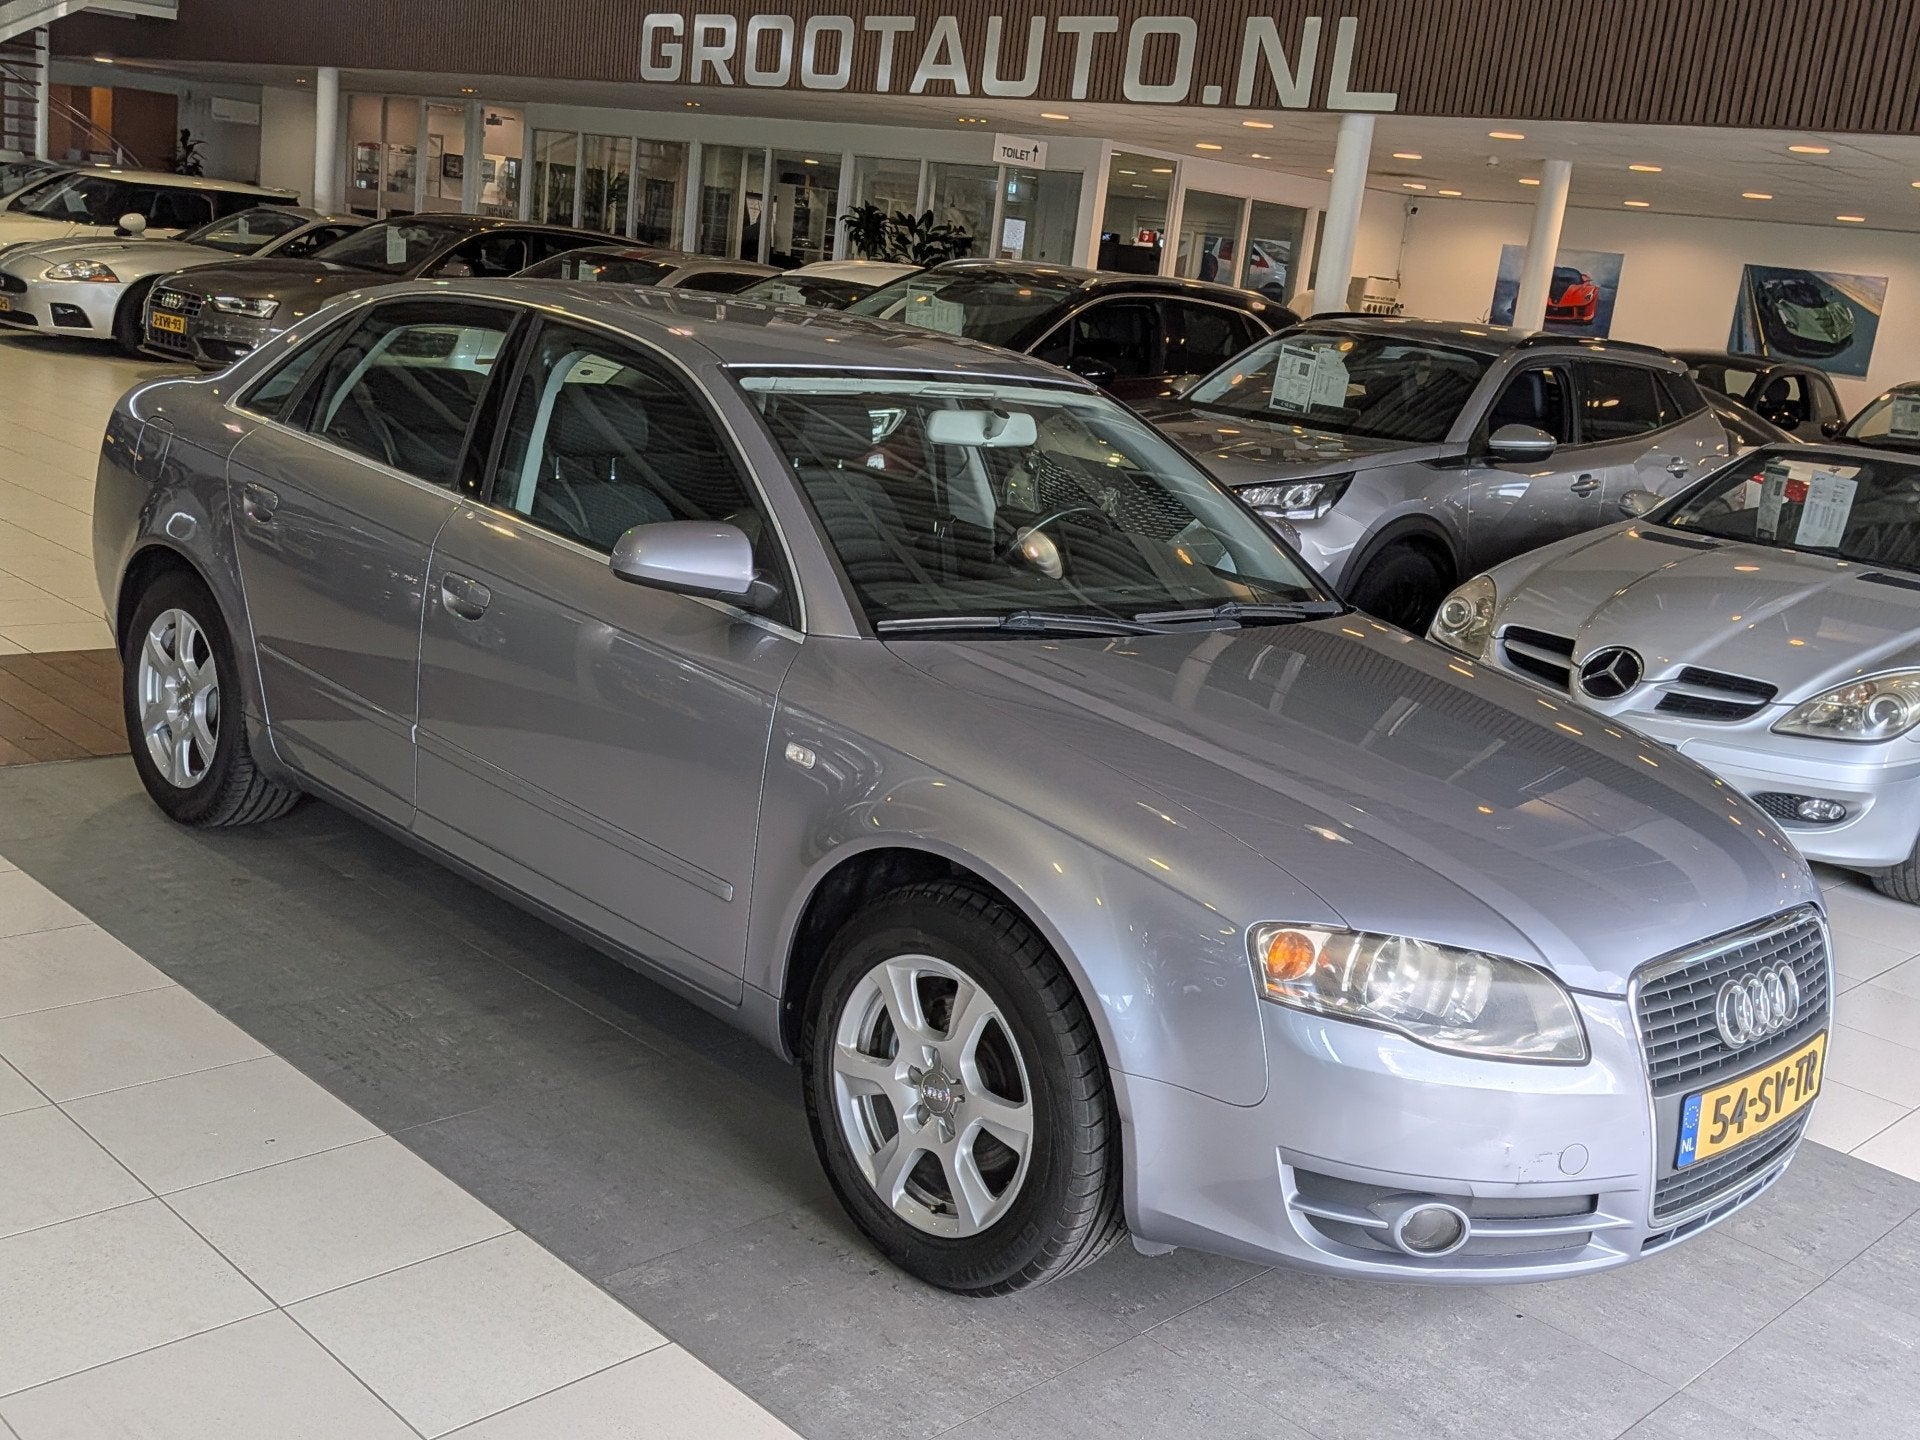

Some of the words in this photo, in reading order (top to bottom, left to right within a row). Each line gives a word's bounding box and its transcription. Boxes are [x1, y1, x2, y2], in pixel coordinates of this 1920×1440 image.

[640, 13, 1398, 112] GROOTAUTO.NL
[1001, 146, 1031, 161] TOILET
[1709, 1049, 1818, 1144] 54-SV-TR
[1681, 1138, 1695, 1154] NL
